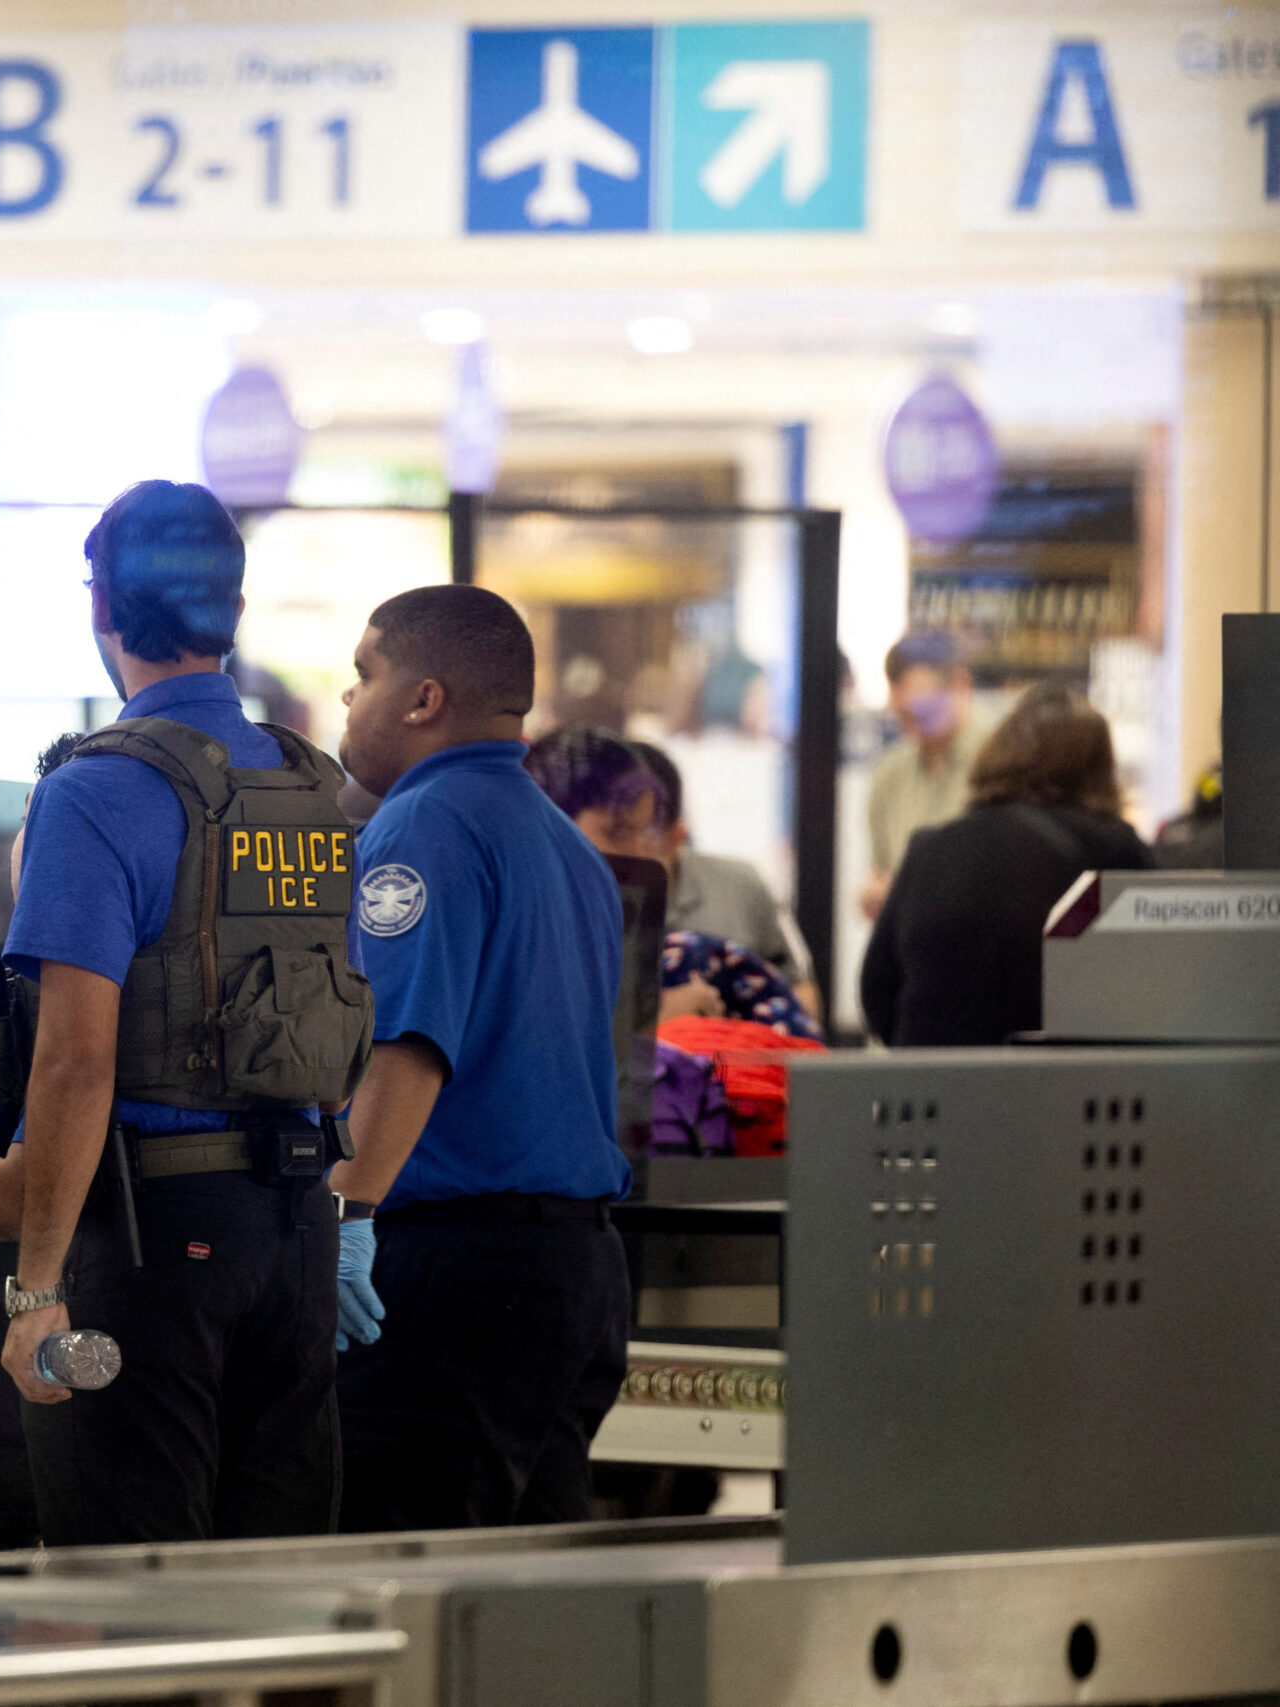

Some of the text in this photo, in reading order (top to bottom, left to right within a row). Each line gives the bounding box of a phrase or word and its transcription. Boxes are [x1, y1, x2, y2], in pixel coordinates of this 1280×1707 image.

[1014, 42, 1135, 210] A
[133, 114, 350, 208] 2-11
[233, 831, 347, 872] POLICE
[268, 877, 317, 907] ICE
[1134, 897, 1229, 921] Rapiscan
